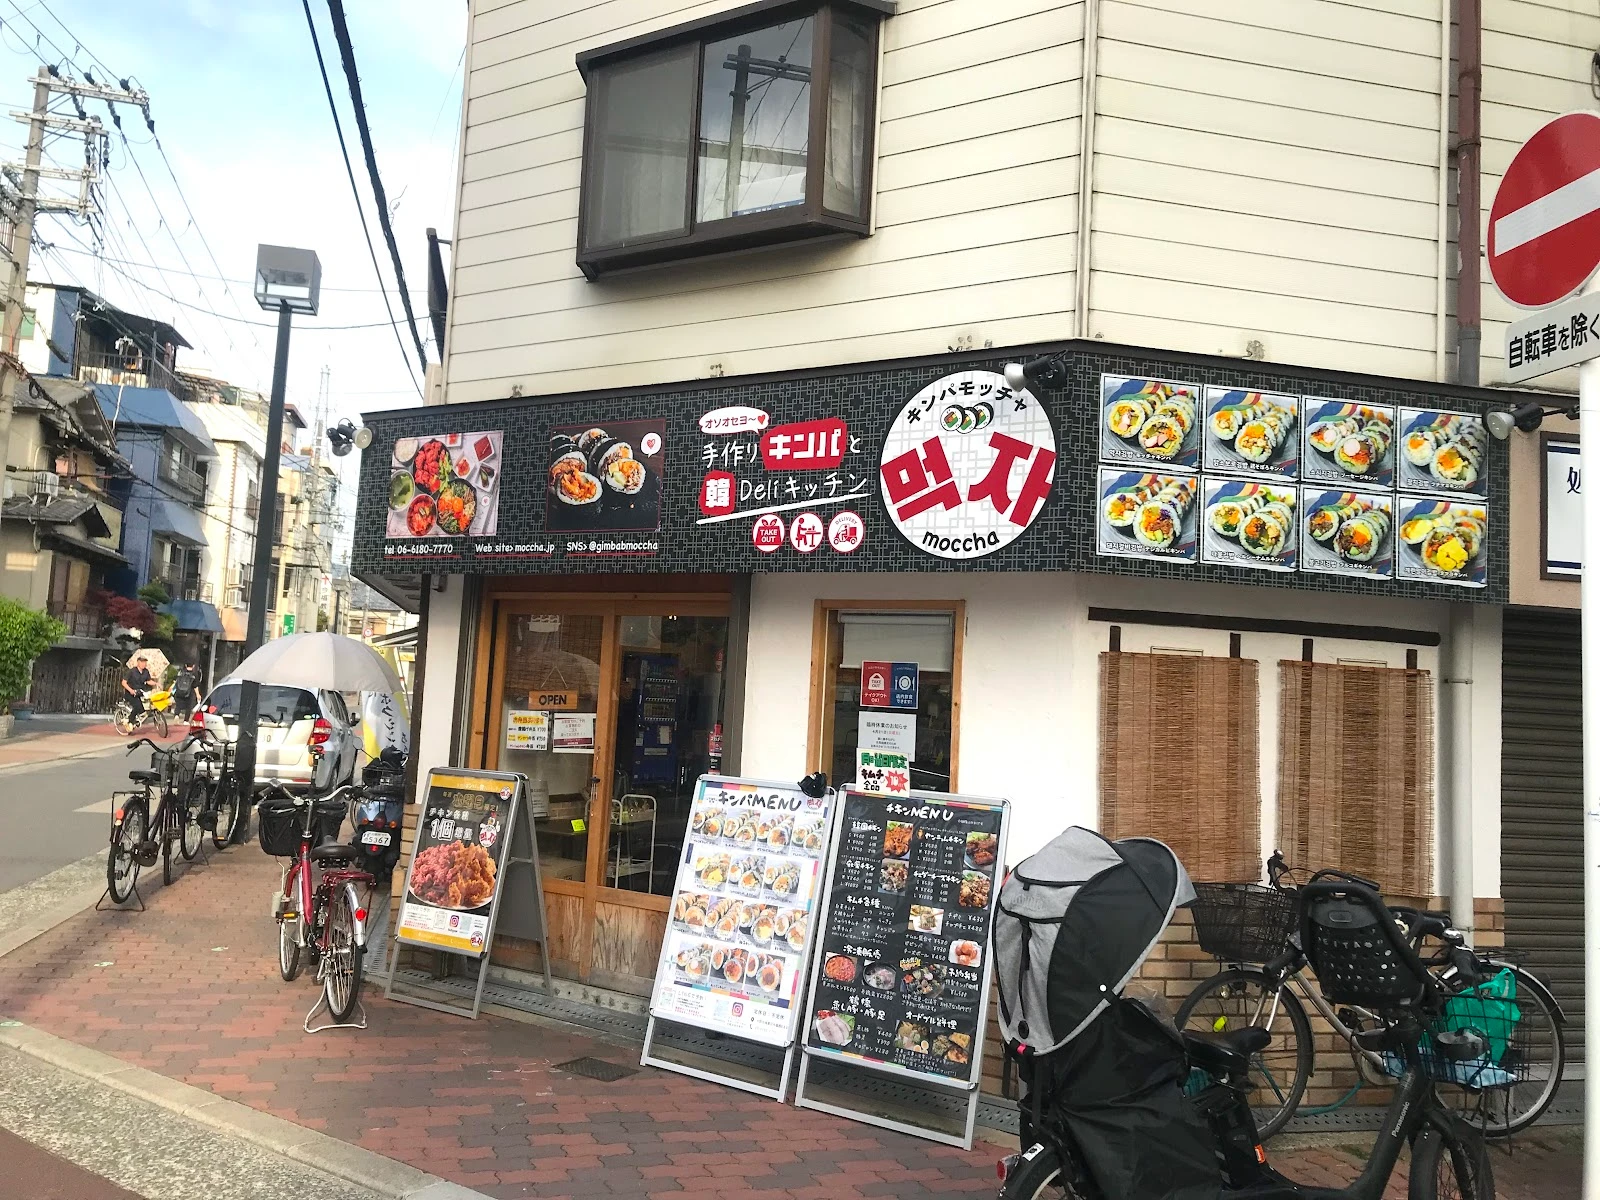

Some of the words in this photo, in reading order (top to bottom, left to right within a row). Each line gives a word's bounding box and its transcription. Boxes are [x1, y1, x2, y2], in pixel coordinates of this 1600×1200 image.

[1509, 312, 1600, 368] 自転車を除く
[907, 381, 1027, 424] キンパモッチャ
[834, 516, 858, 525] DELIVERY
[384, 544, 394, 555] tel
[397, 543, 453, 554] 06-6180-7770
[475, 543, 492, 553] Web
[922, 531, 1000, 552] moccha
[538, 694, 567, 706] OPEN
[861, 769, 884, 780] キムチ
[864, 780, 880, 791] 全品
[718, 790, 802, 812] キンパMENU
[886, 802, 954, 822] チキンMENU
[847, 895, 881, 908] キムチ各種
[906, 1011, 957, 1029] オードブル料理
[1391, 1101, 1410, 1138] Panasonic
